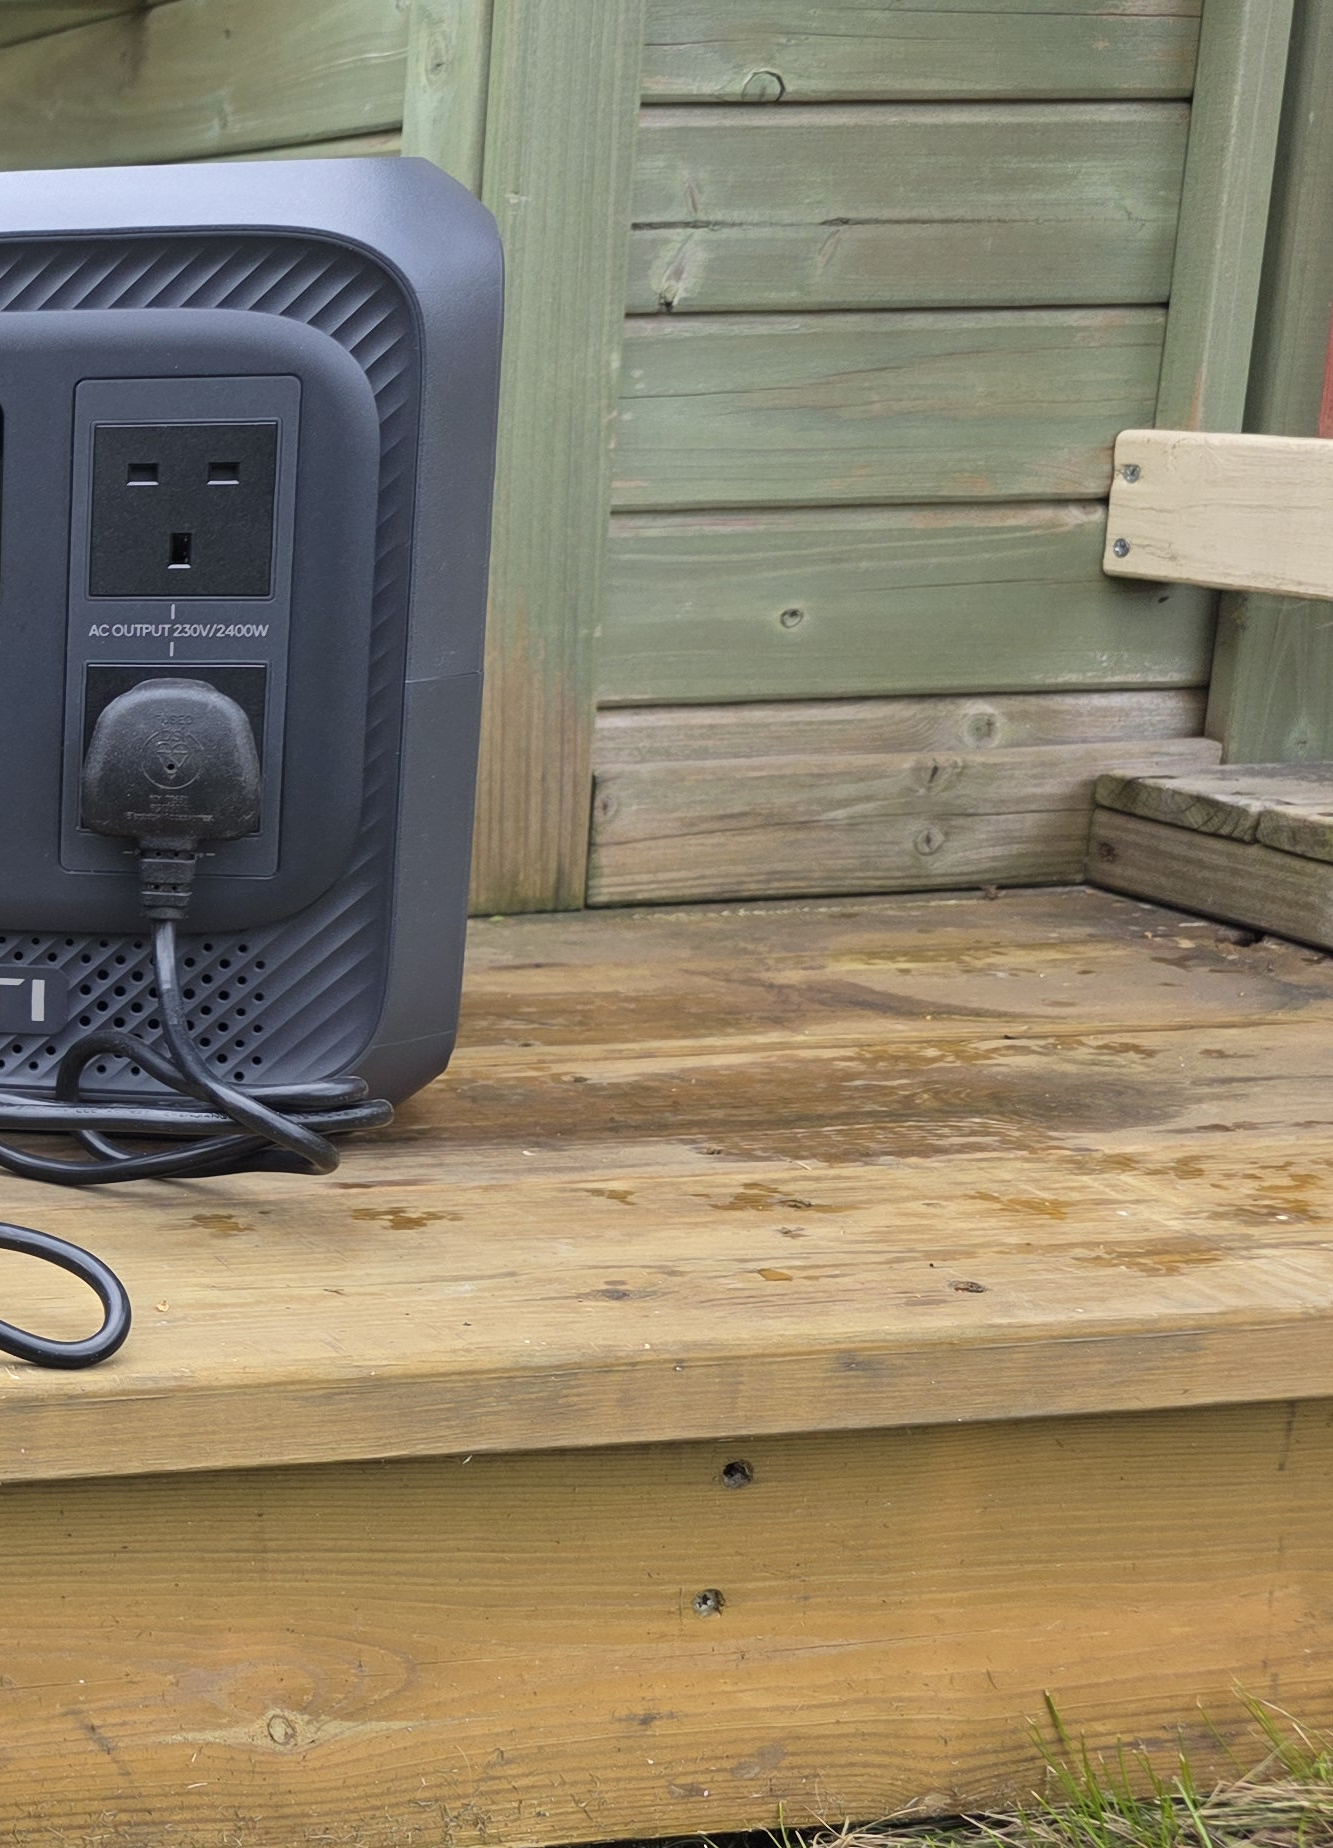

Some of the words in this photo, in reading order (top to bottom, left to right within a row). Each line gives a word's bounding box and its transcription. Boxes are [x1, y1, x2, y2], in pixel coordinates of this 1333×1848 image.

[88, 624, 110, 637] AC
[112, 624, 172, 637] OUTPUT
[172, 624, 270, 638] 230V/2400W
